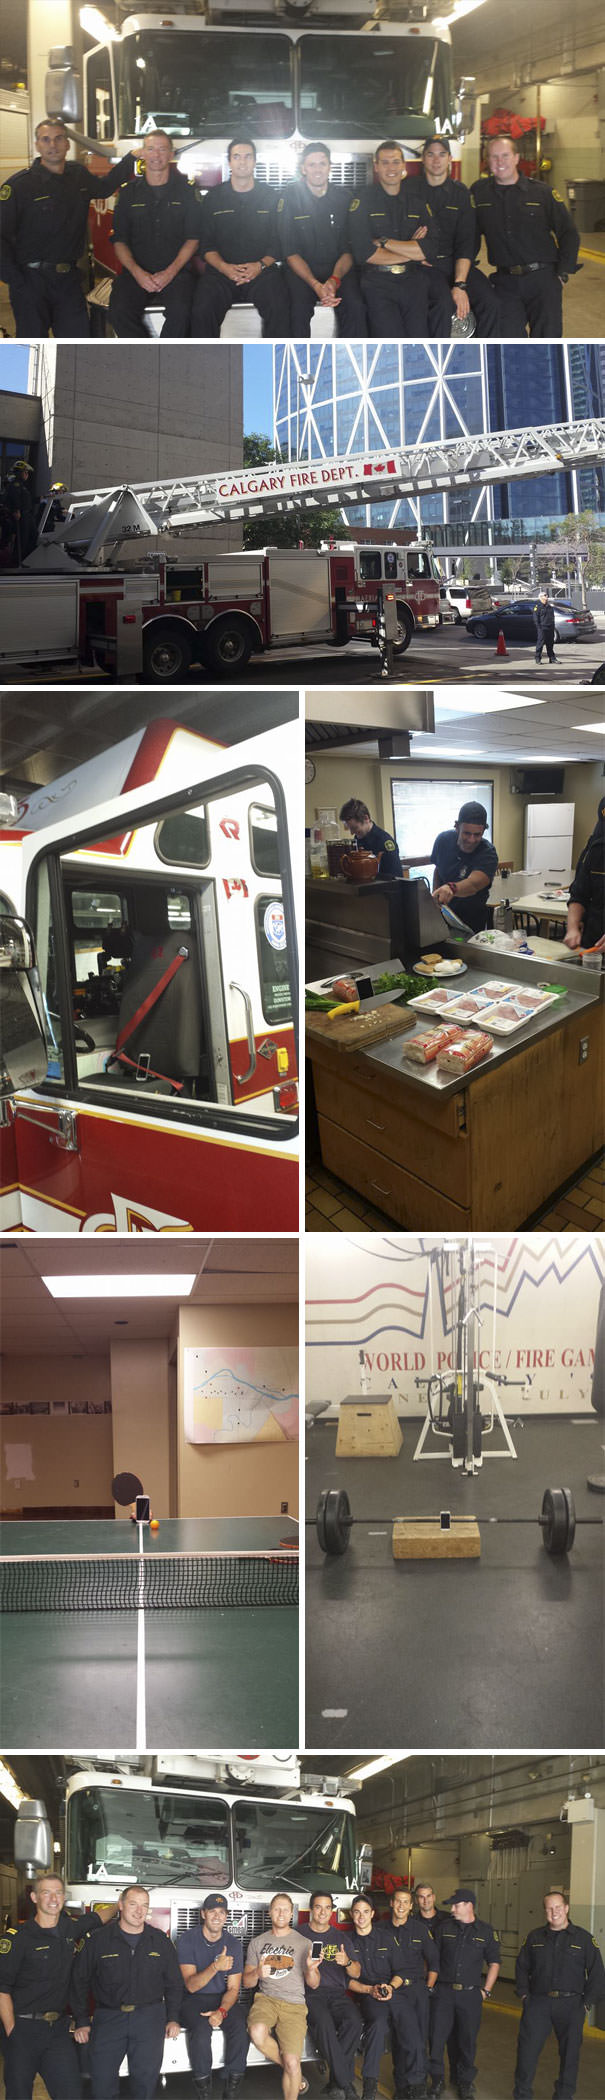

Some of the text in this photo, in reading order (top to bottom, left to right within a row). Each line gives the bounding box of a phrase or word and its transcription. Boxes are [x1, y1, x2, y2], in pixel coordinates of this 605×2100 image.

[434, 116, 454, 134] 1A
[218, 465, 359, 497] CALGARY FIRE DEPT.
[437, 1350, 502, 1370] POICE
[516, 1349, 556, 1369] FIRE
[88, 1863, 109, 1877] 1A
[345, 1876, 360, 1890] 1A
[260, 1943, 295, 1956] Electric
